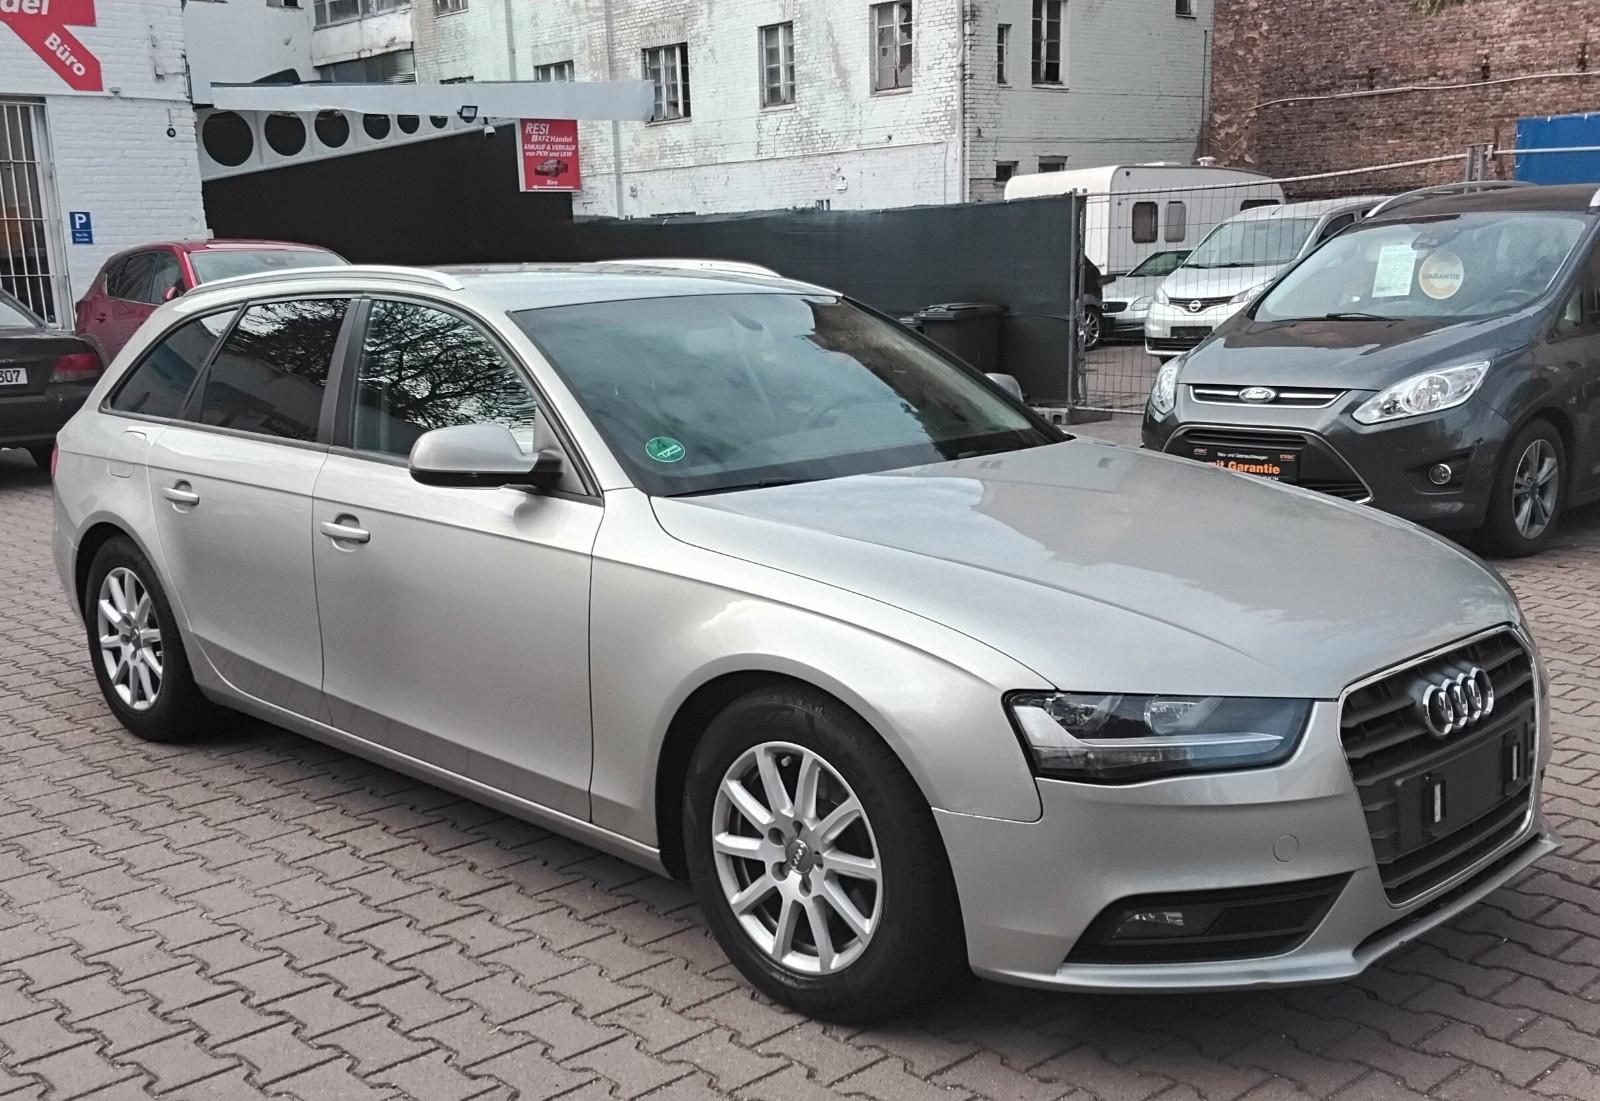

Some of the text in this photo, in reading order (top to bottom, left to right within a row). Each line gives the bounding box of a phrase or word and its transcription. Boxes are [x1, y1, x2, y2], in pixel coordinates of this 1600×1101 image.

[44, 32, 86, 76] Büro
[525, 122, 549, 134] RESI
[74, 213, 87, 229] P
[1228, 461, 1280, 474] Garantie
